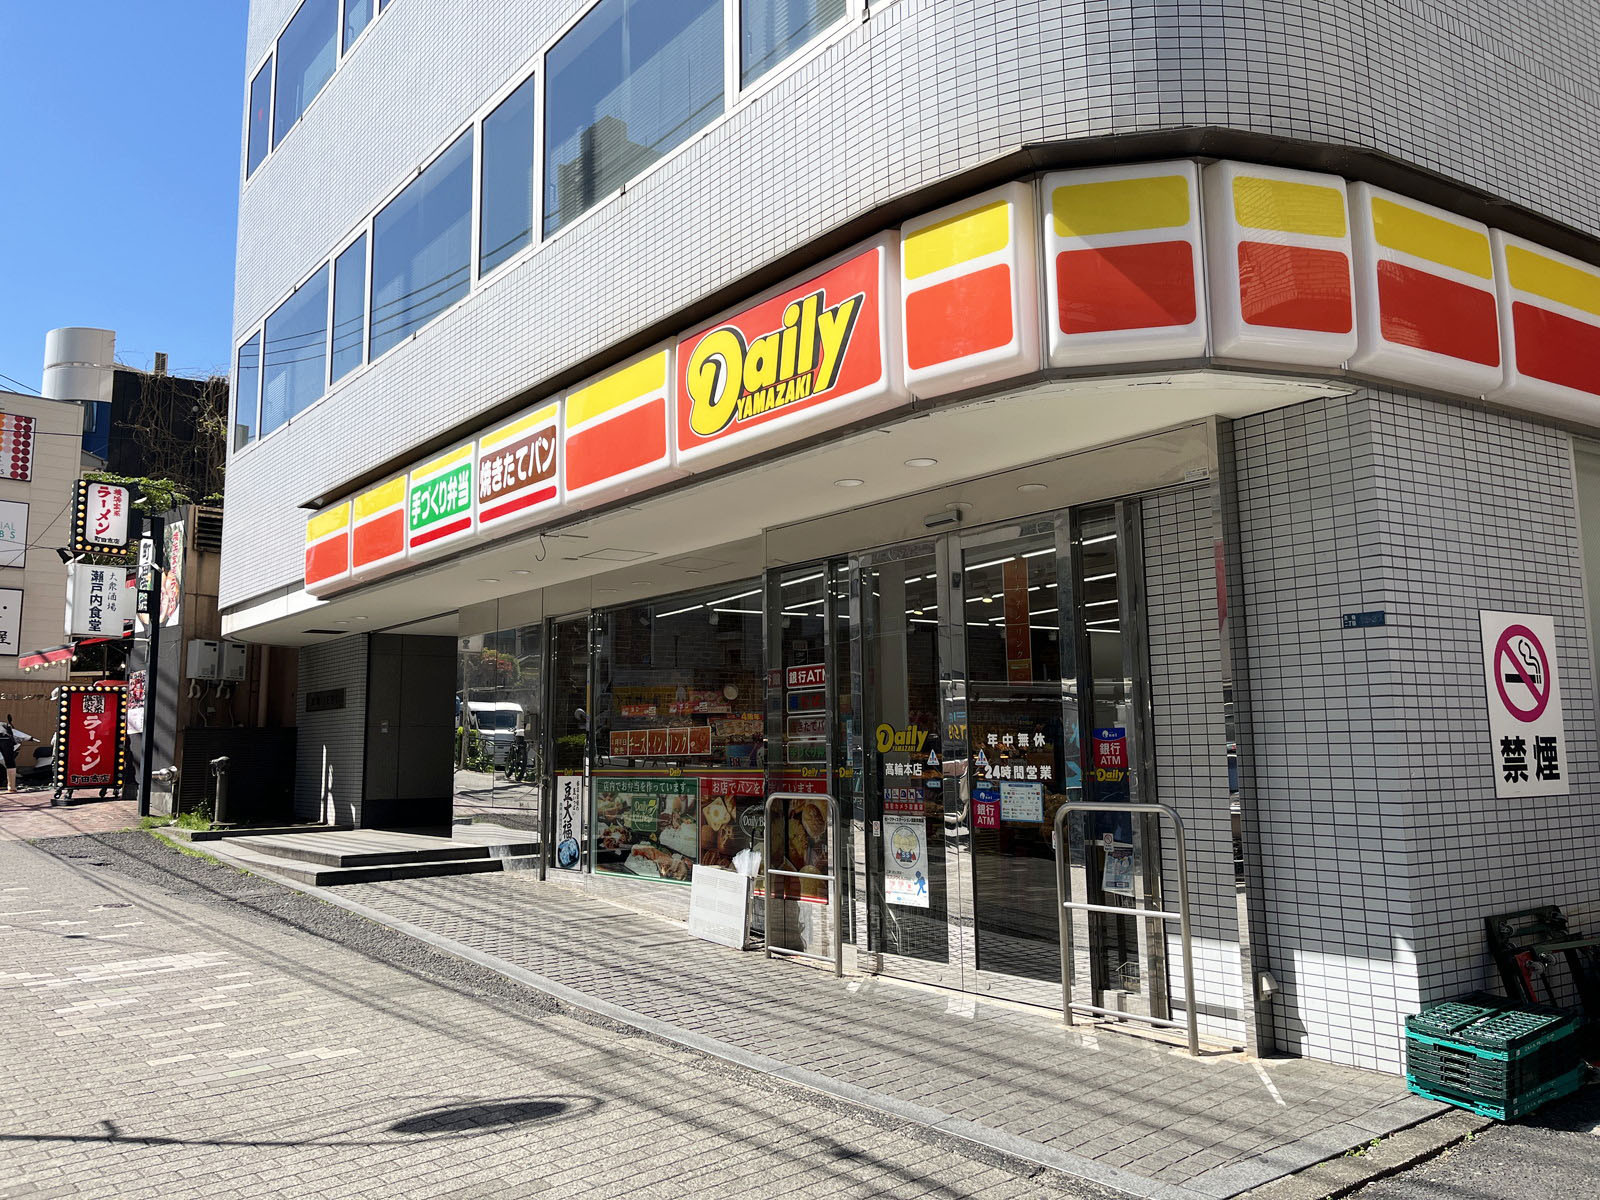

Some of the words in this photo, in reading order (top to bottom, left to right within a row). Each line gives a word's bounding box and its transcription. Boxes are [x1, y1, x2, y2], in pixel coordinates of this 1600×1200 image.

[687, 289, 865, 437] Daily
[737, 371, 813, 421] YAMAZAKI
[480, 436, 555, 498] 焼きたてパン
[95, 486, 111, 535] ラーメン
[411, 469, 469, 526] 手づくり弁当
[88, 570, 104, 632] 瀬戸内食堂
[106, 572, 118, 612] 大衆酒場
[81, 715, 102, 771] ラーメン
[876, 723, 928, 753] Daily
[987, 732, 1046, 747] 年中無休
[1099, 742, 1121, 755] 銀行
[885, 762, 922, 776] 高輪本店
[984, 765, 1052, 780] 24時間営業
[1096, 768, 1124, 782] Daily
[1100, 756, 1121, 765] ATM
[1500, 735, 1560, 784] 禁煙
[977, 804, 995, 816] 銀行
[977, 816, 995, 825] ATM
